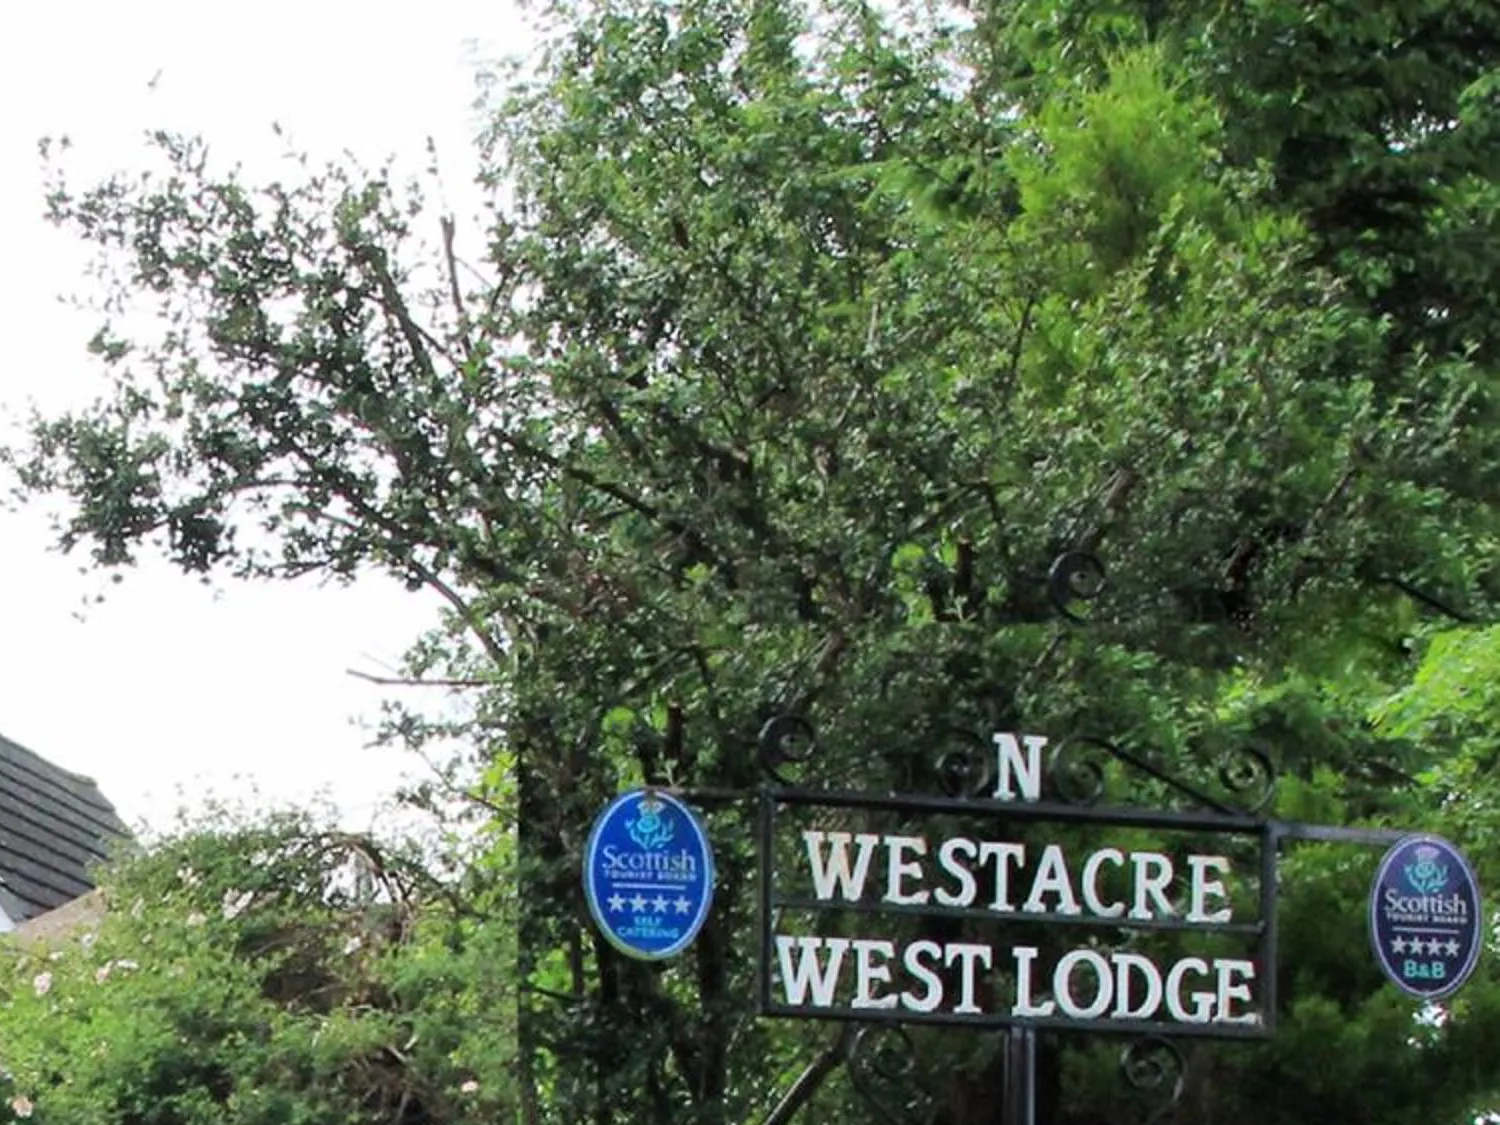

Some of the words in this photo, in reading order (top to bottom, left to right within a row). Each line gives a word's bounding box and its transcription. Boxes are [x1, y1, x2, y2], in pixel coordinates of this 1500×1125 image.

[602, 845, 696, 872] Scottish
[803, 831, 1233, 924] WESTACRE
[1384, 888, 1467, 916] Scottish
[617, 926, 679, 939] CATERING
[776, 935, 992, 1016] WEST
[1012, 947, 1259, 1025] LODGE
[1403, 959, 1446, 979] B&B
